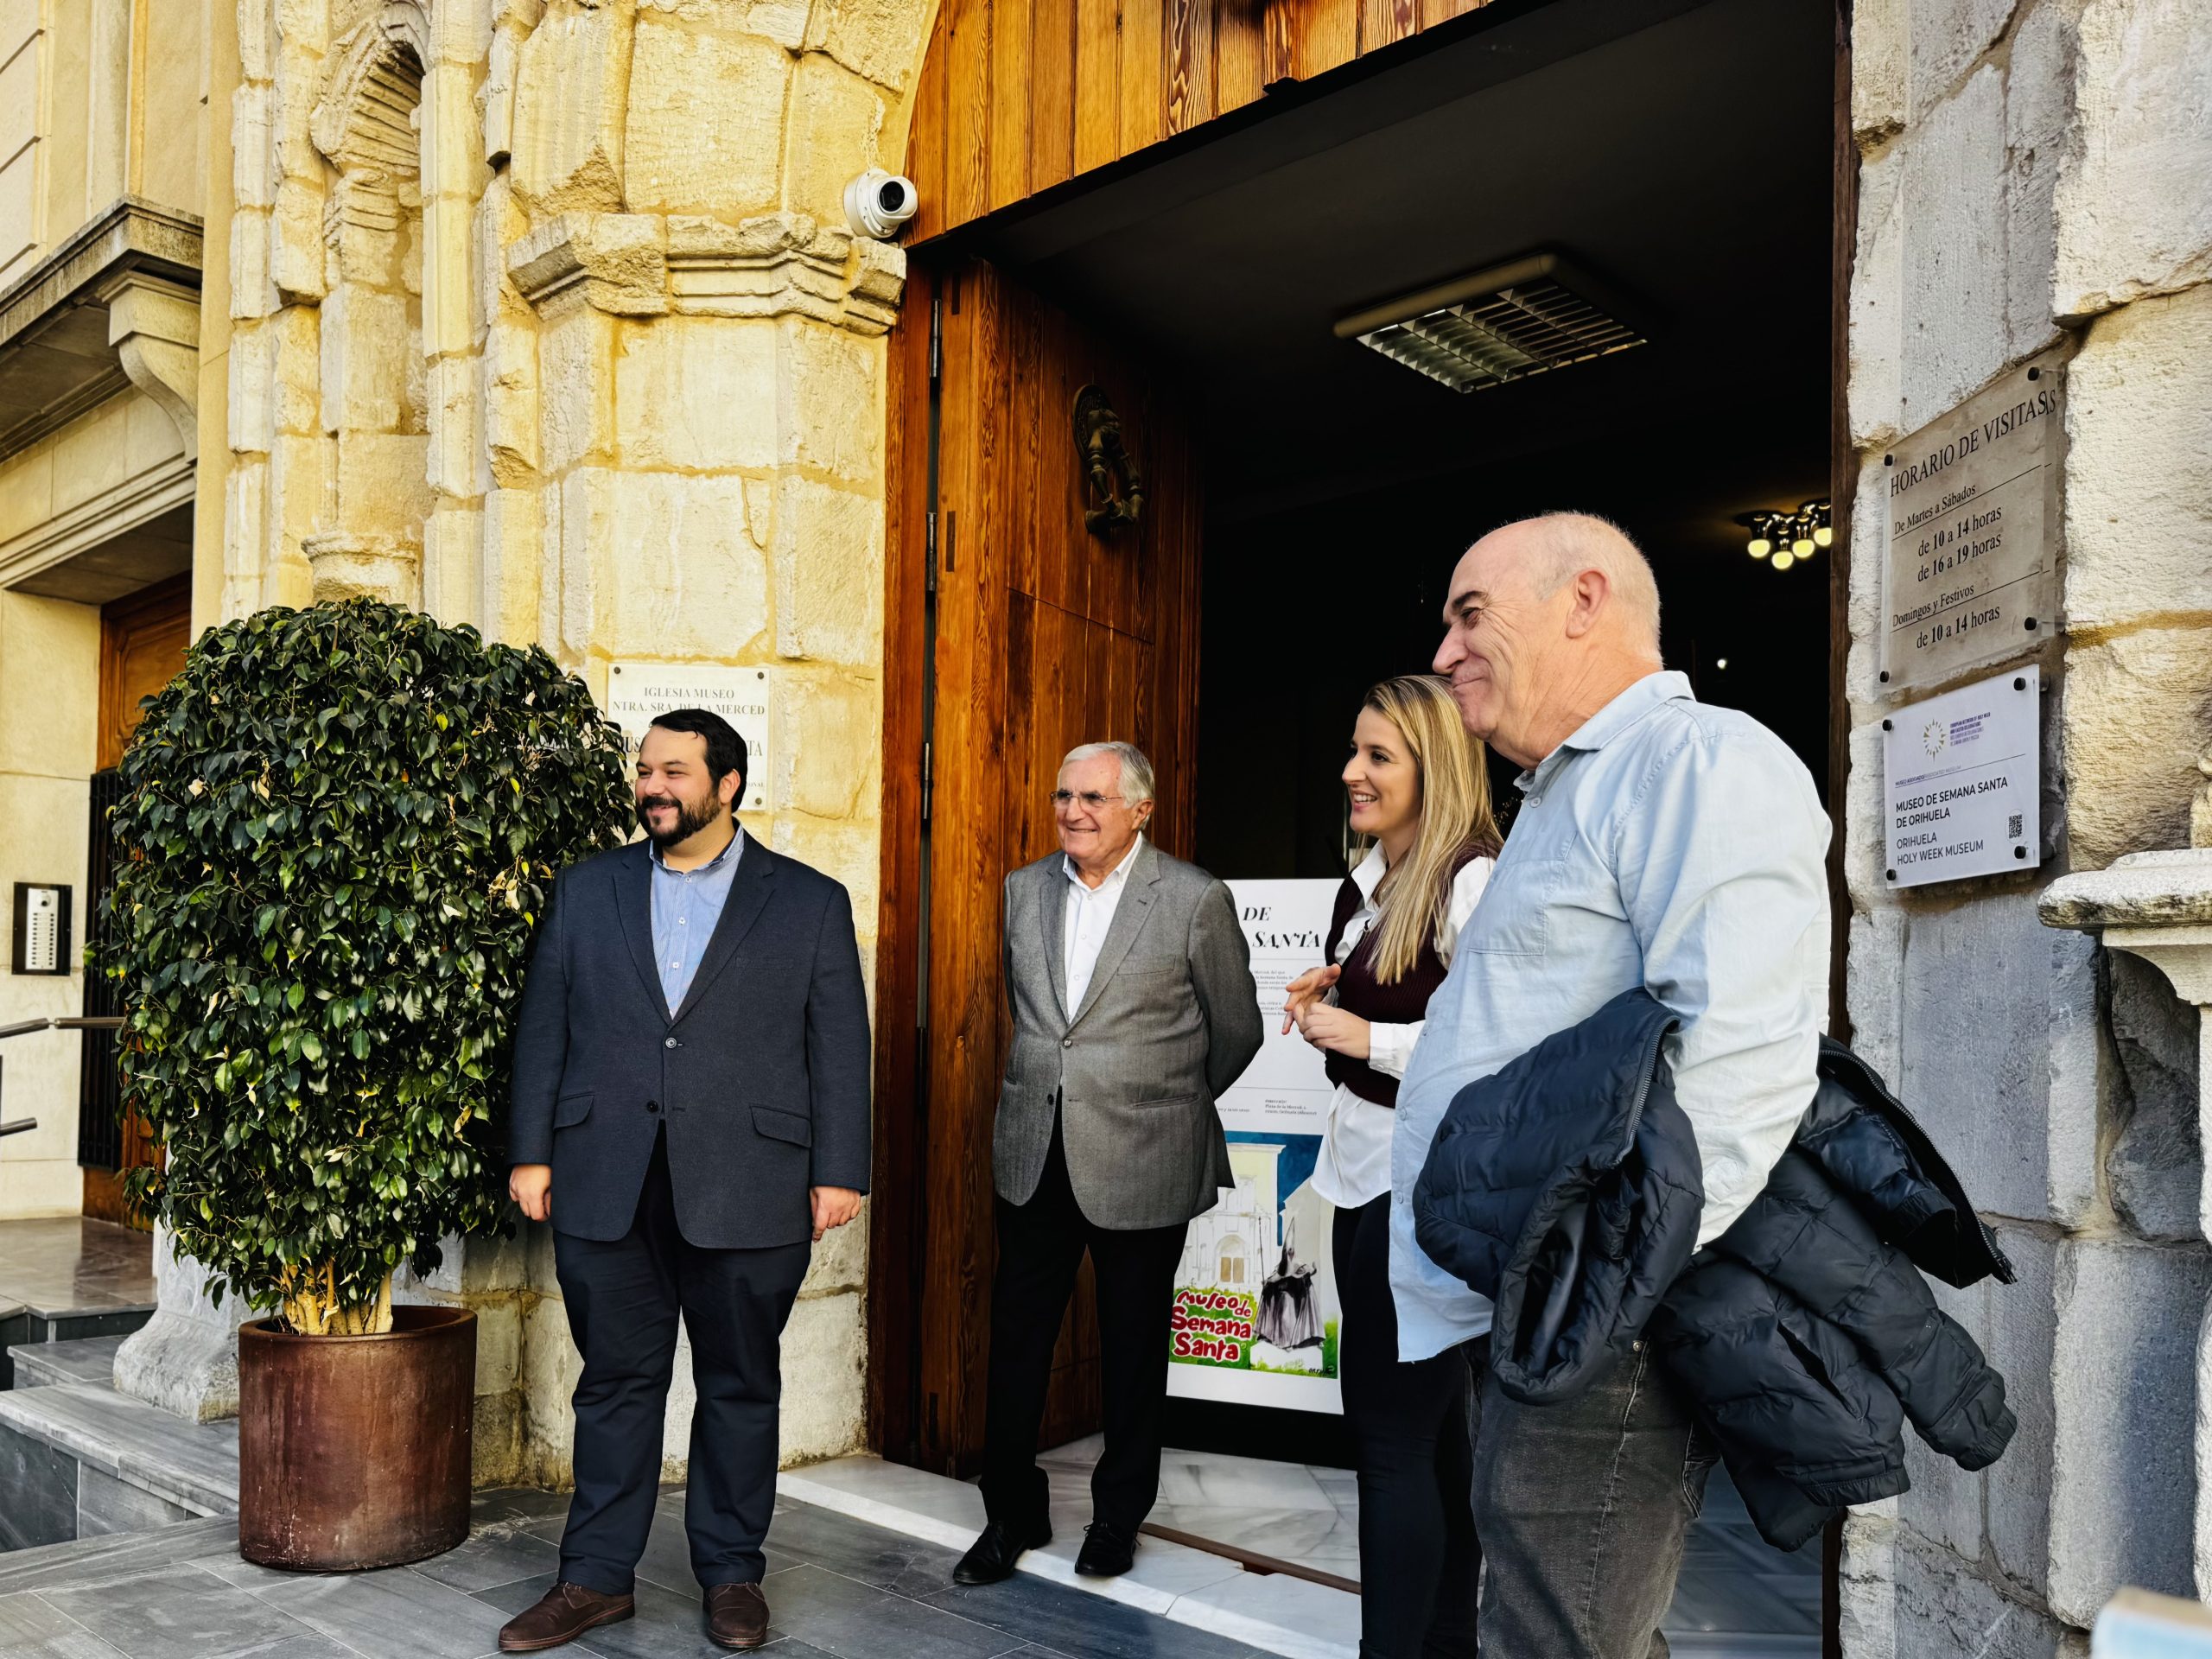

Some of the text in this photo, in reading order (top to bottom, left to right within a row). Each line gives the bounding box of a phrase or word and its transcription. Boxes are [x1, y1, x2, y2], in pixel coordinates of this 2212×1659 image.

[1890, 444, 1955, 498] HORARIO
[1959, 429, 1980, 459] DE
[1894, 485, 1976, 535] De Martes a Sábados
[1918, 506, 2002, 557] de 10 a 14 horas
[1917, 533, 2001, 582] de 16 a 19 horas
[1892, 585, 1974, 627] Domingos y Festivos
[1916, 606, 2000, 649] de 10 a 14 horas
[645, 687, 734, 699] IGLESIA MUSEO
[613, 701, 647, 711] NTRA.
[715, 704, 765, 715] MERCED
[1896, 777, 2008, 813] MUSEO DE SEMANA SANTA
[1897, 807, 1950, 829] DE ORIHUELA
[1897, 831, 1937, 849] ORIHUELA
[1897, 839, 1984, 865] HOLY WEEK MUSEUM
[1243, 906, 1271, 921] DE
[1252, 931, 1319, 949] SANTA
[1171, 1306, 1251, 1338] Semana
[1234, 1300, 1251, 1317] de
[1173, 1332, 1239, 1361] Santa
